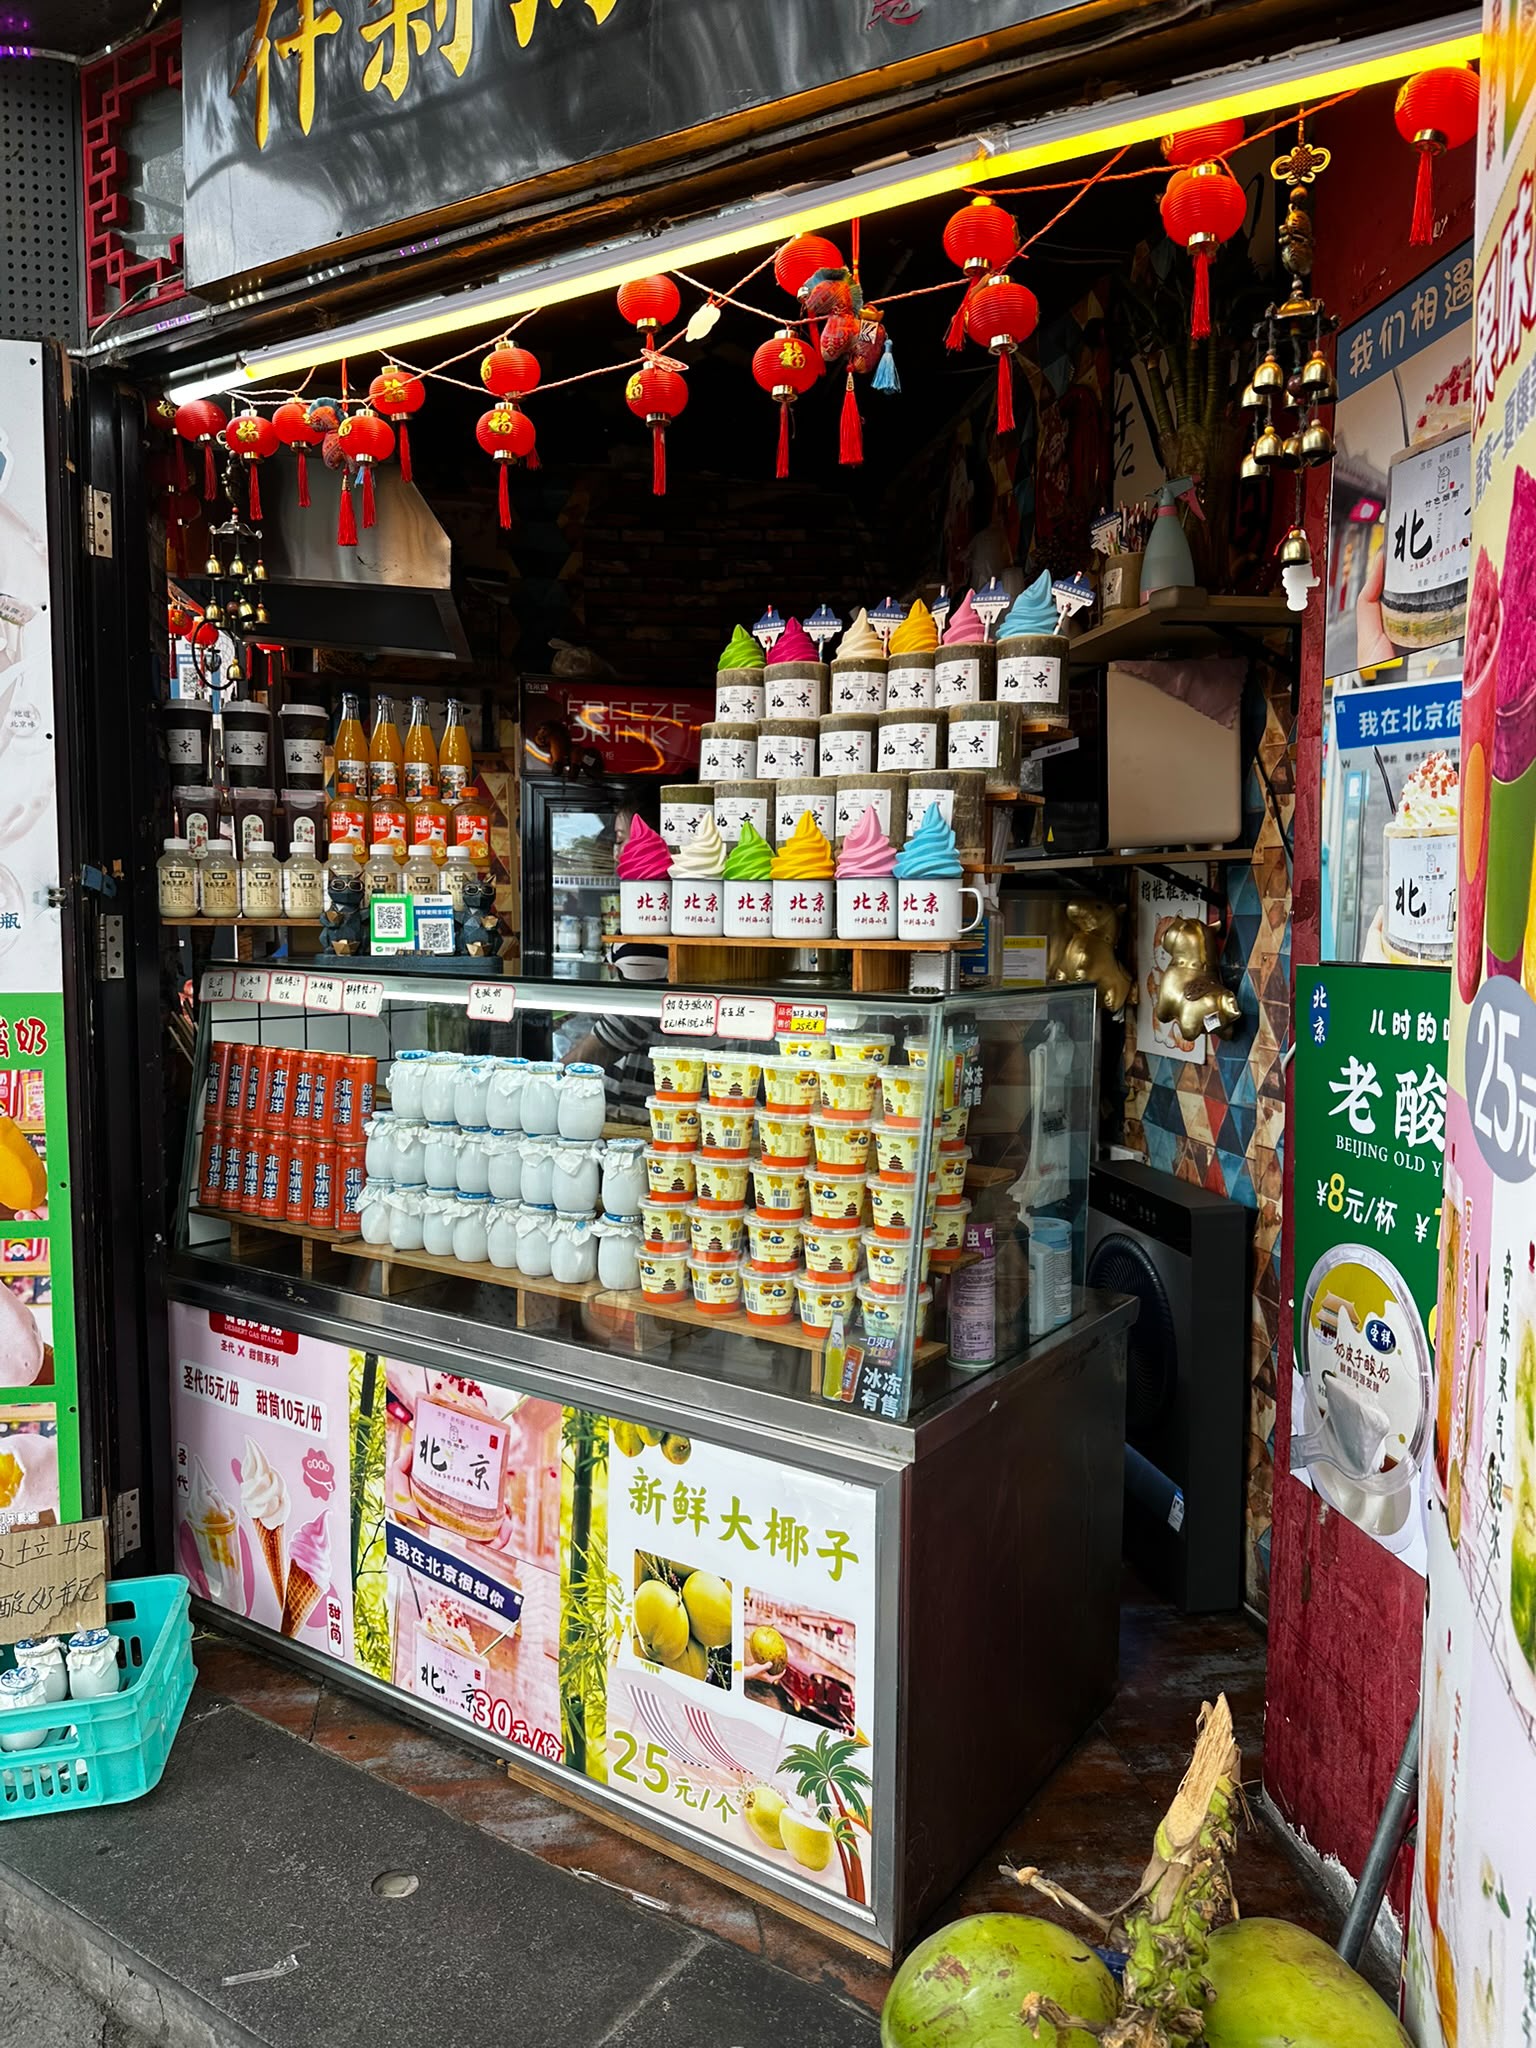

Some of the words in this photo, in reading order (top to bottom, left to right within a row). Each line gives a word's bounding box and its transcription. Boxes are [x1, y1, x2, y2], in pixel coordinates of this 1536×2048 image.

[229, 0, 616, 150] 什刹
[1349, 257, 1473, 378] 我们相遇
[1472, 168, 1536, 443] 果味
[567, 700, 691, 723] FREEZE
[332, 817, 352, 826] HPP
[374, 818, 394, 827] HPP
[416, 820, 434, 829] HPP
[457, 821, 476, 830] HPP
[637, 892, 670, 912] 北京
[684, 893, 719, 912] 北京
[738, 893, 773, 912] 北京
[790, 893, 826, 913] 北京
[853, 891, 890, 913] 北京
[903, 893, 939, 914] 北京
[1313, 986, 1328, 1043] 北京
[227, 1063, 243, 1108] 北冰洋
[247, 1066, 259, 1110] 北冰洋
[270, 1069, 288, 1114] 北冰洋
[294, 1072, 314, 1117] 北冰洋
[313, 1074, 326, 1121] 北冰洋
[338, 1078, 353, 1125] 北冰洋
[224, 1147, 241, 1192] 北冰洋
[244, 1151, 259, 1197] 北冰洋
[1336, 1134, 1389, 1163] BEIJING
[1394, 1151, 1426, 1174] OLD
[262, 1155, 280, 1200] 北冰洋
[288, 1159, 304, 1204] 北冰洋
[314, 1163, 331, 1210] 北冰洋
[221, 1339, 236, 1354] 圣代
[1370, 1324, 1392, 1348] 圣祥
[863, 1366, 902, 1395] 冰冻
[1334, 1338, 1391, 1384] 奶皮子酸奶
[183, 1365, 240, 1407] 圣代15元/份
[256, 1388, 323, 1433] 甜筒10元/份
[861, 1388, 899, 1419] 有售
[176, 1447, 189, 1492] 圣代
[306, 1458, 330, 1473] GOOD
[419, 1434, 491, 1492] 北京
[627, 1467, 859, 1582] 新鲜大椰子
[394, 1536, 506, 1610] 我在北京很想你
[328, 1602, 342, 1646] 甜筒
[612, 1730, 739, 1824] 25元/个
